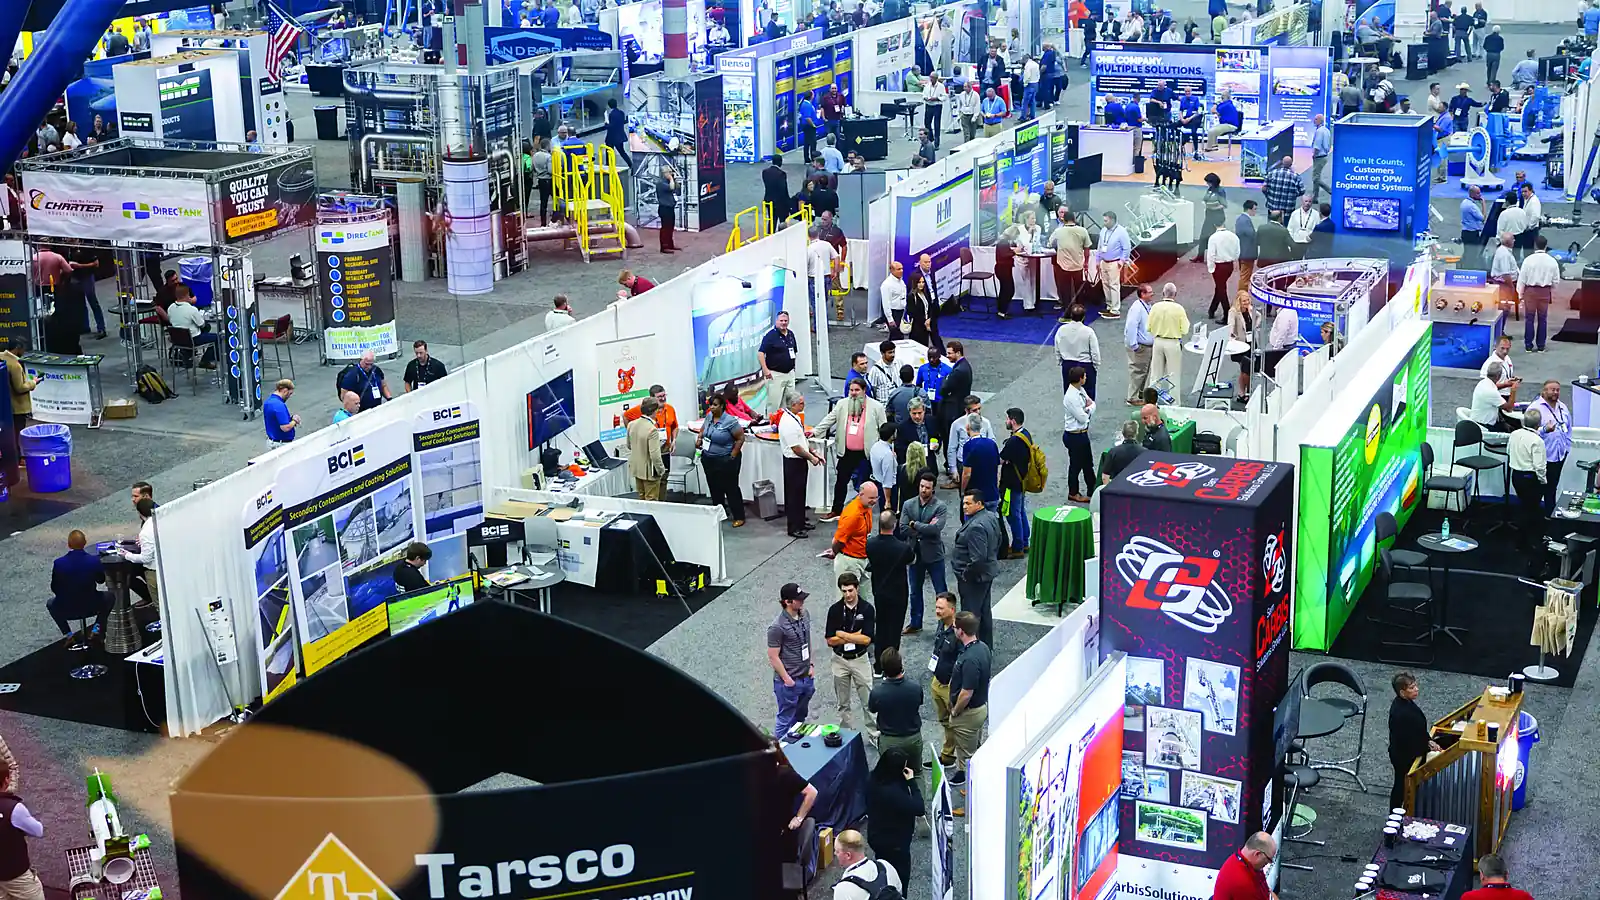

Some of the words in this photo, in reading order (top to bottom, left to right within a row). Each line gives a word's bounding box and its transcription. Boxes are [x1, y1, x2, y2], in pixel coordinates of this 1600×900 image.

[721, 59, 750, 68] Denso
[1096, 56, 1115, 64] ONE
[1116, 56, 1163, 65] COMPANY.
[1096, 64, 1142, 74] MULTIPLE
[1144, 65, 1204, 75] SOLUTIONS.
[1343, 156, 1366, 164] When
[1376, 157, 1405, 167] Counts,
[1353, 166, 1394, 174] Customers
[230, 173, 268, 193] QUALITY
[1335, 181, 1379, 190] Engineered
[1381, 183, 1413, 192] Systems
[1345, 173, 1369, 182] Count
[1382, 175, 1403, 183] OPW
[230, 190, 249, 204] YOU
[249, 185, 269, 199] CAN
[45, 202, 104, 213] CHARTER
[236, 198, 266, 215] TRUST
[1269, 294, 1285, 306] TANK
[1292, 299, 1322, 311] VESSEL
[418, 430, 445, 441] Secondary
[445, 422, 479, 435] Containment
[432, 436, 453, 444] Coating
[453, 430, 477, 440] Solutions
[1194, 461, 1265, 500] CARBIS
[289, 502, 318, 521] Secondary
[318, 487, 354, 508] Containment
[353, 482, 365, 493] and
[364, 472, 385, 488] Coating
[385, 461, 409, 477] Solutions
[1236, 484, 1261, 502] Solutions
[1256, 593, 1289, 659] CARBIS
[1256, 647, 1273, 672] Solutions
[415, 844, 635, 899] Tarsco
